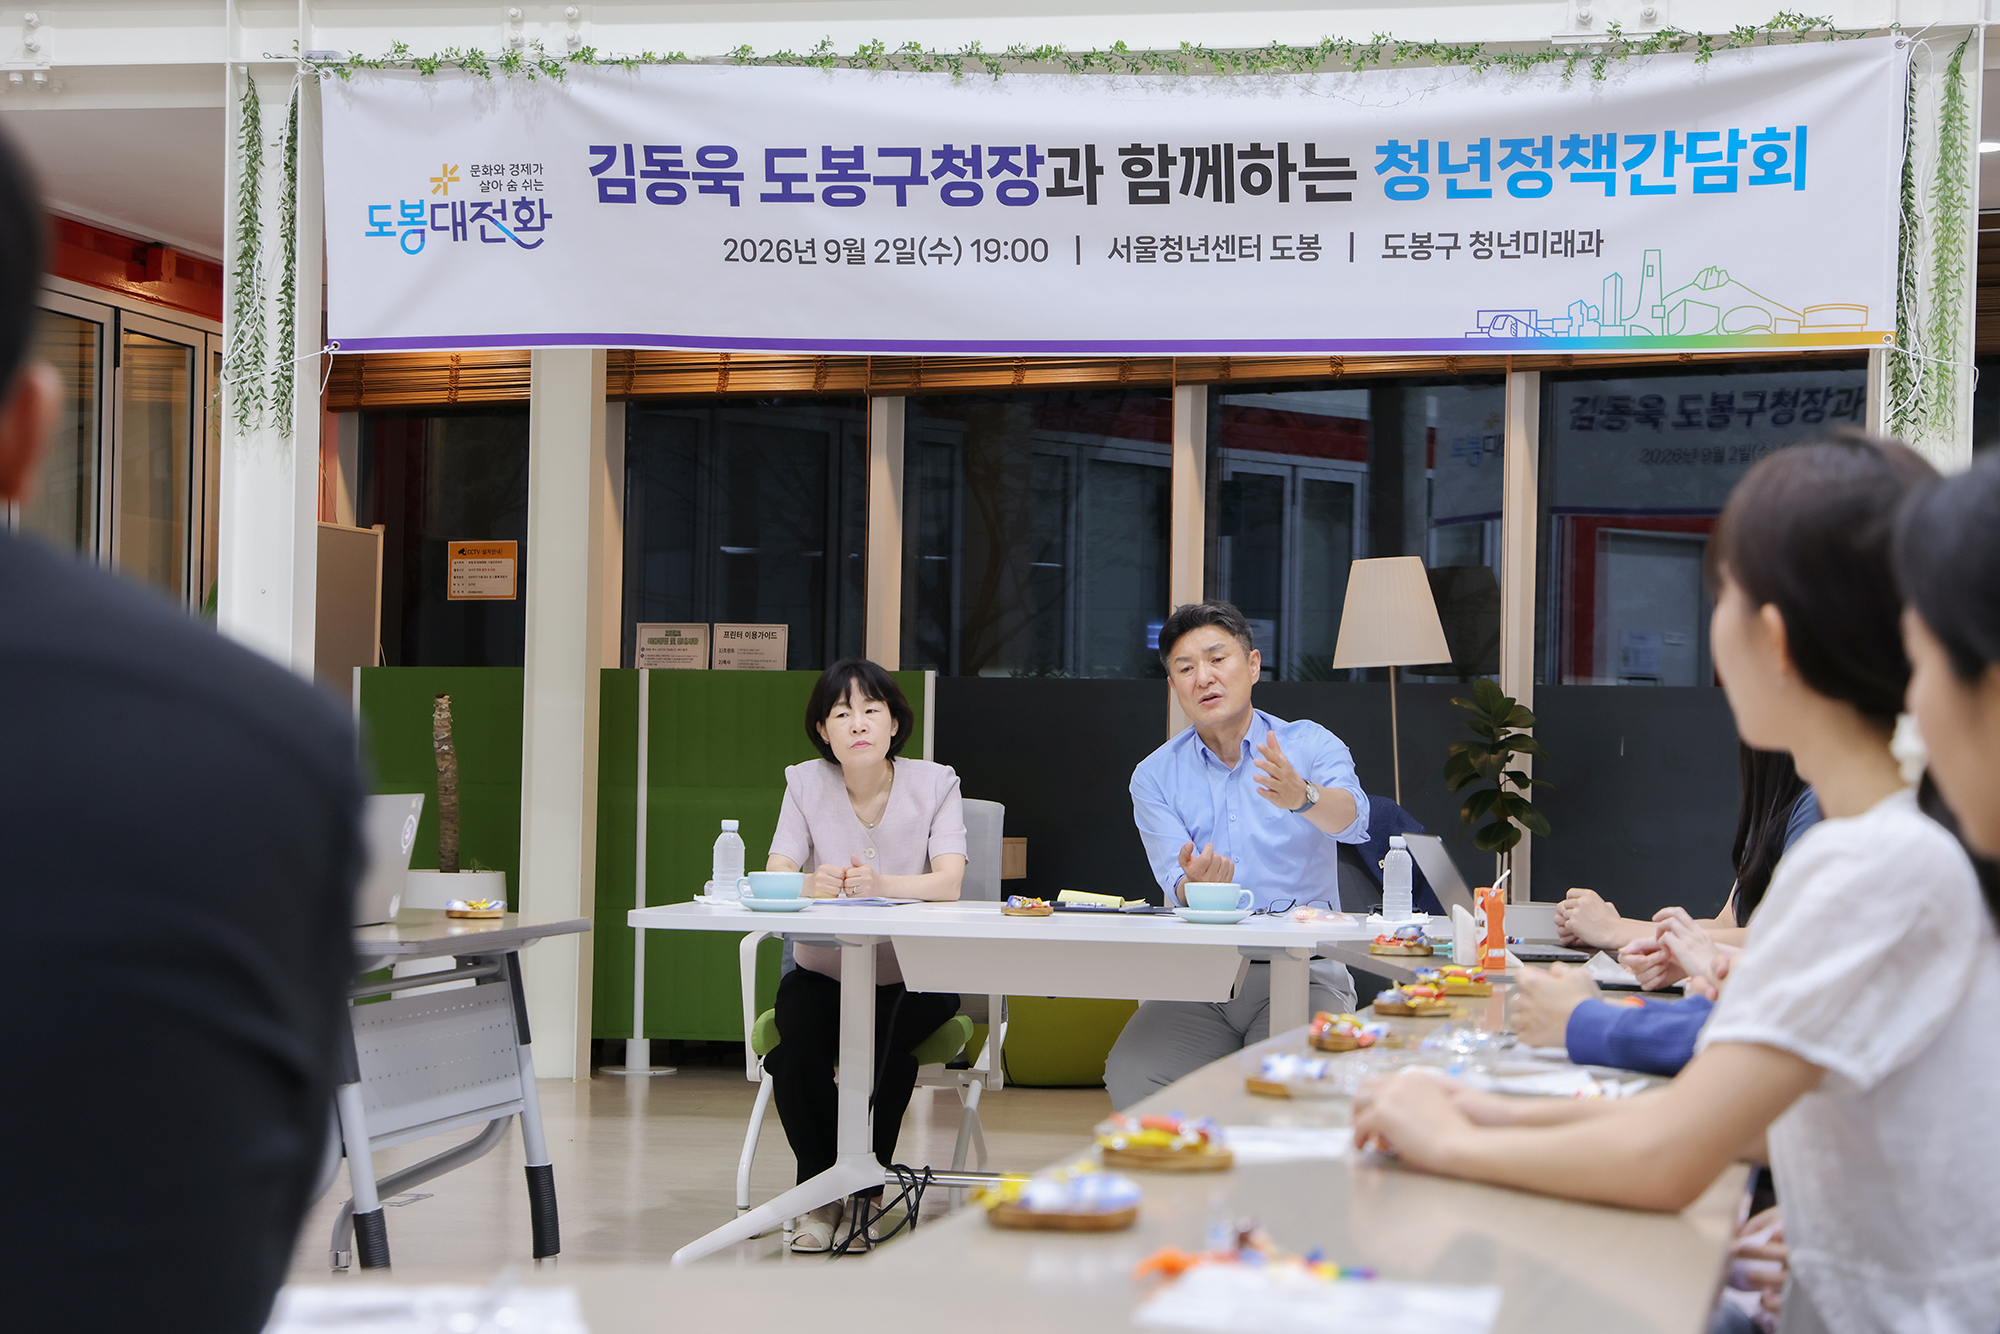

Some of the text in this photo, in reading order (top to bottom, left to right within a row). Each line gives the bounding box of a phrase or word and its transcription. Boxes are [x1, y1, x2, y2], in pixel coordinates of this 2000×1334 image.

[470, 163, 543, 177] 문화와 경제가
[589, 126, 1807, 207] 김동욱 도봉구청장과 함께하는 청년정책간담회
[479, 179, 543, 192] 살아 숨 쉬는
[365, 196, 552, 255] 도봉대전환
[724, 229, 1604, 266] 2026년 9월 2일(수) 19:00 서울청년센터 도봉 도봉구 청년미래과
[723, 631, 778, 640] 프린터 이용가이드
